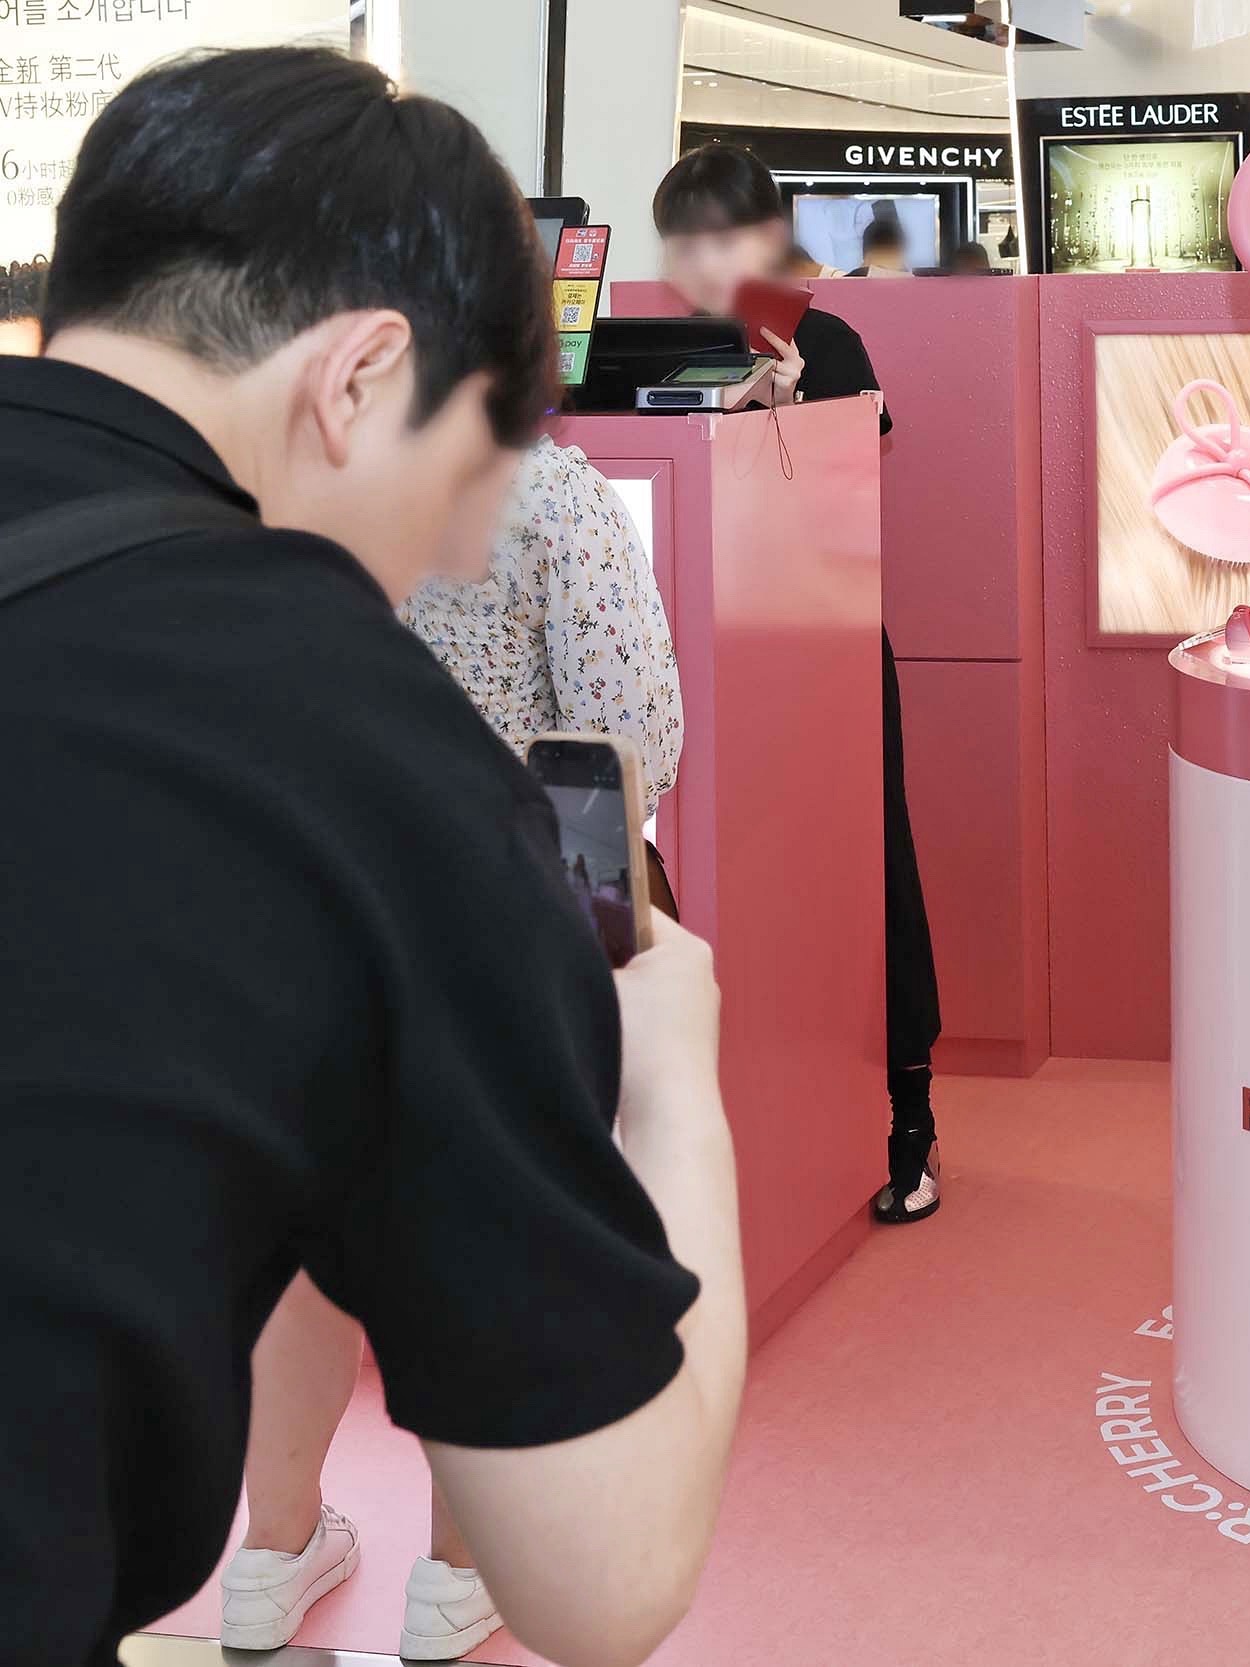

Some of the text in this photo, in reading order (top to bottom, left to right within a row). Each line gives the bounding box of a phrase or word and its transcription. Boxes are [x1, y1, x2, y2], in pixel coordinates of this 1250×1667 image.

[49, 53, 122, 82] 第二代
[1131, 103, 1218, 125] LAUDER
[844, 145, 1003, 168] GIVENCHY
